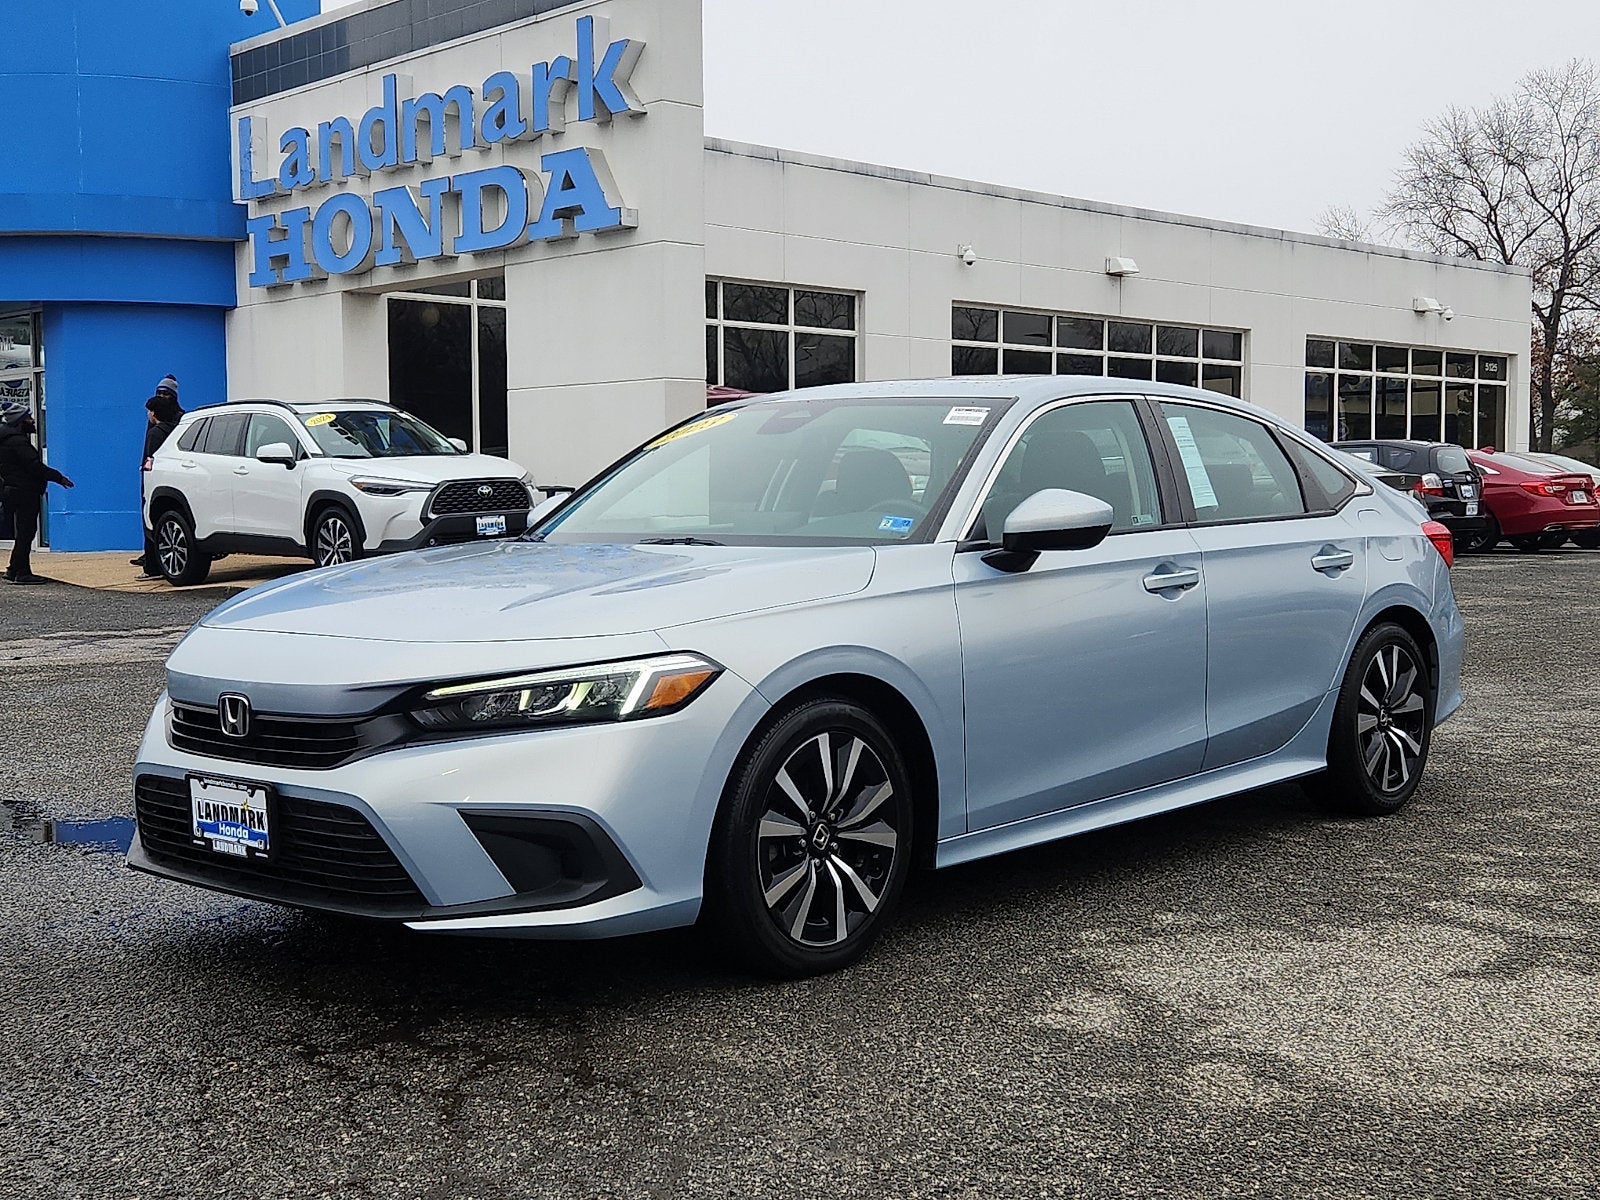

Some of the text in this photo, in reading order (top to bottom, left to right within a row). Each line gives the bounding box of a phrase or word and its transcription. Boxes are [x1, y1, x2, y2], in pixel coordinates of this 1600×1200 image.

[238, 15, 642, 200] Landmark
[247, 146, 632, 289] HONDA
[1484, 362, 1498, 372] 5125
[197, 800, 266, 831] LANDMARK
[219, 823, 249, 838] Honda
